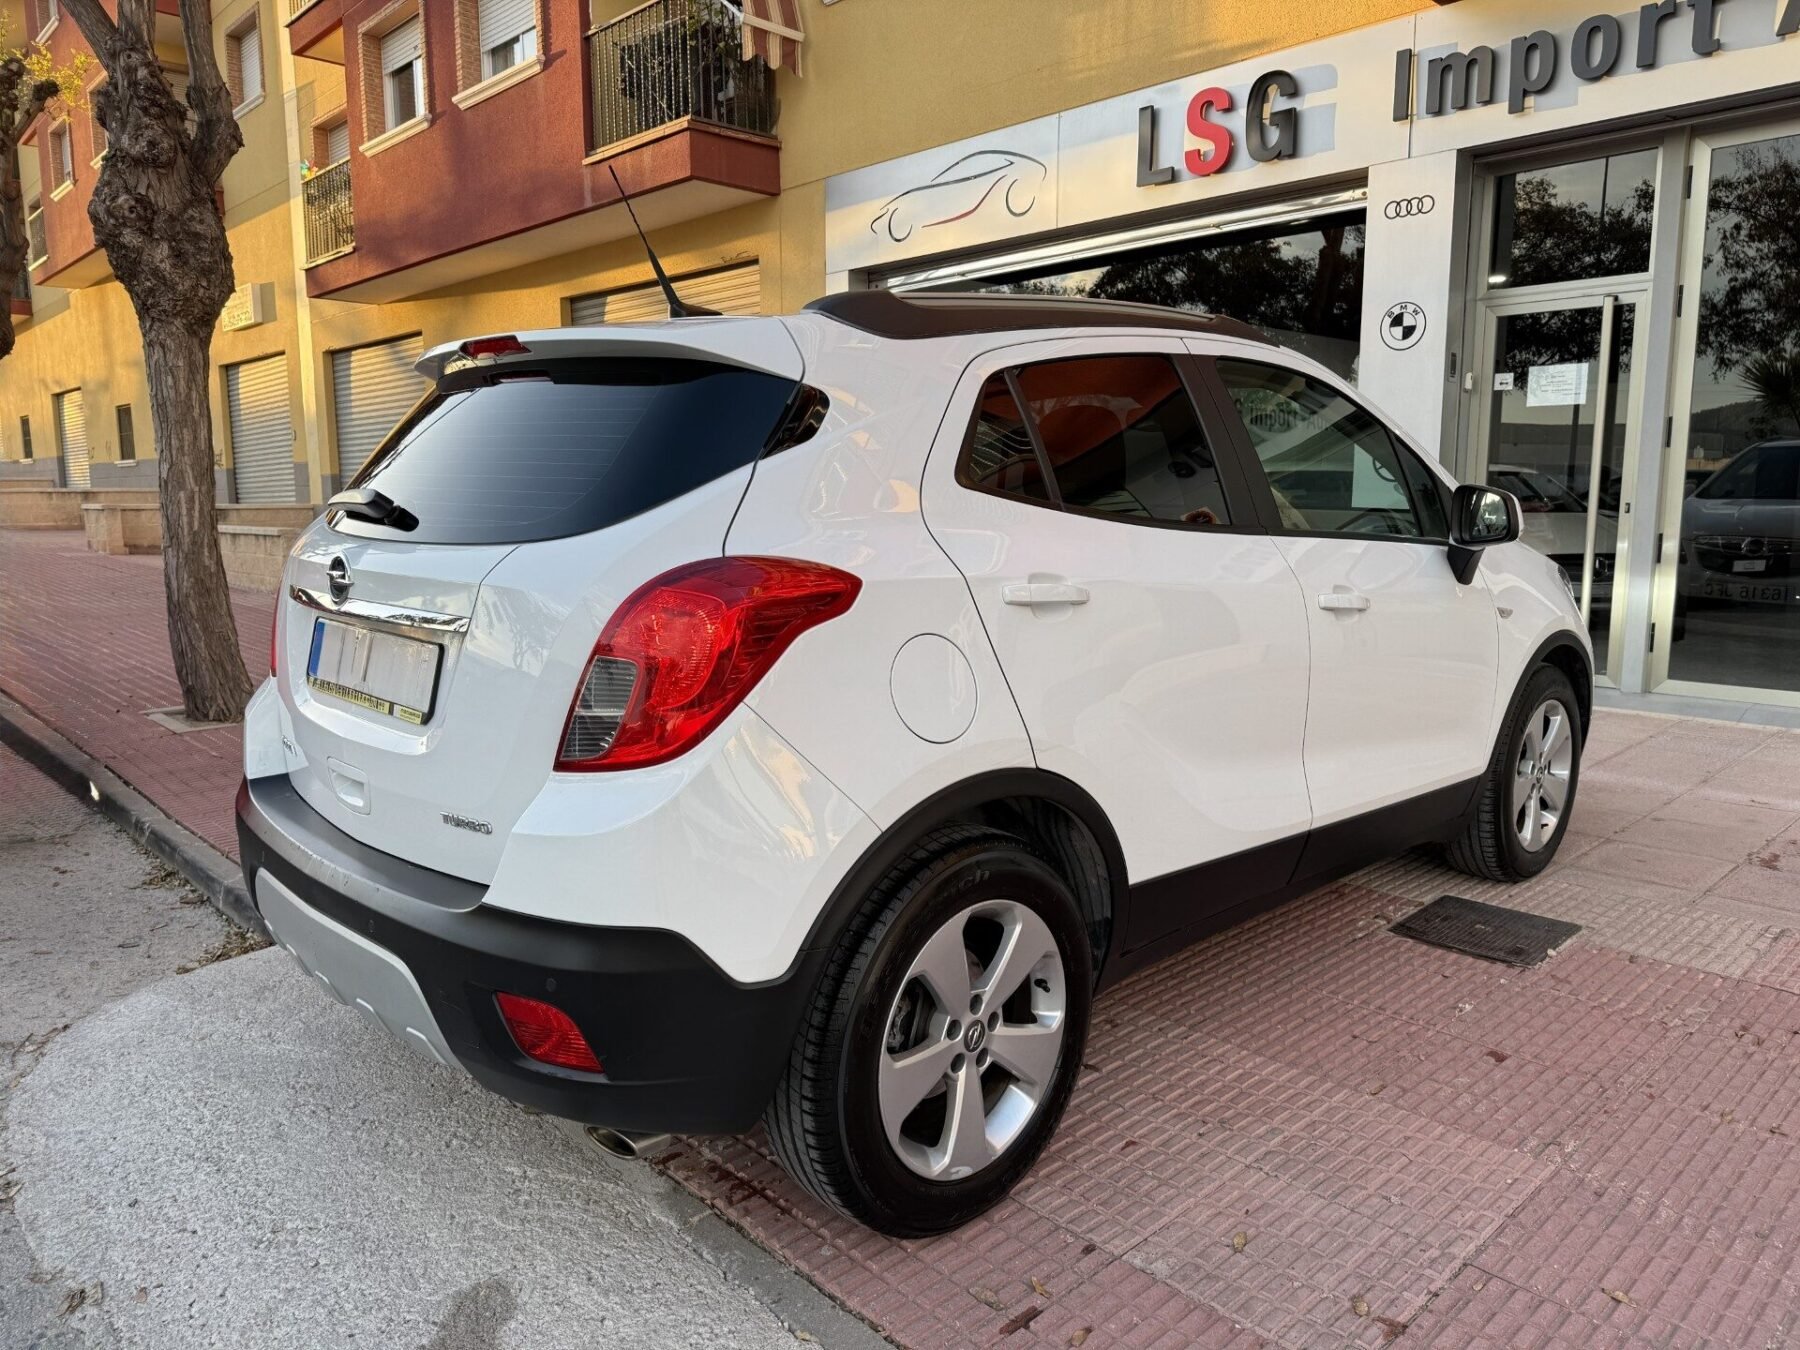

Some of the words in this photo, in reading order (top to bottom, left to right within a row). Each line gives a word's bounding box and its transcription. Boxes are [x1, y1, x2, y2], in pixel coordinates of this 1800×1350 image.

[1137, 70, 1297, 187] LSG
[1393, 0, 1720, 122] Import
[1387, 304, 1420, 319] BMW
[440, 811, 492, 834] TURBO
